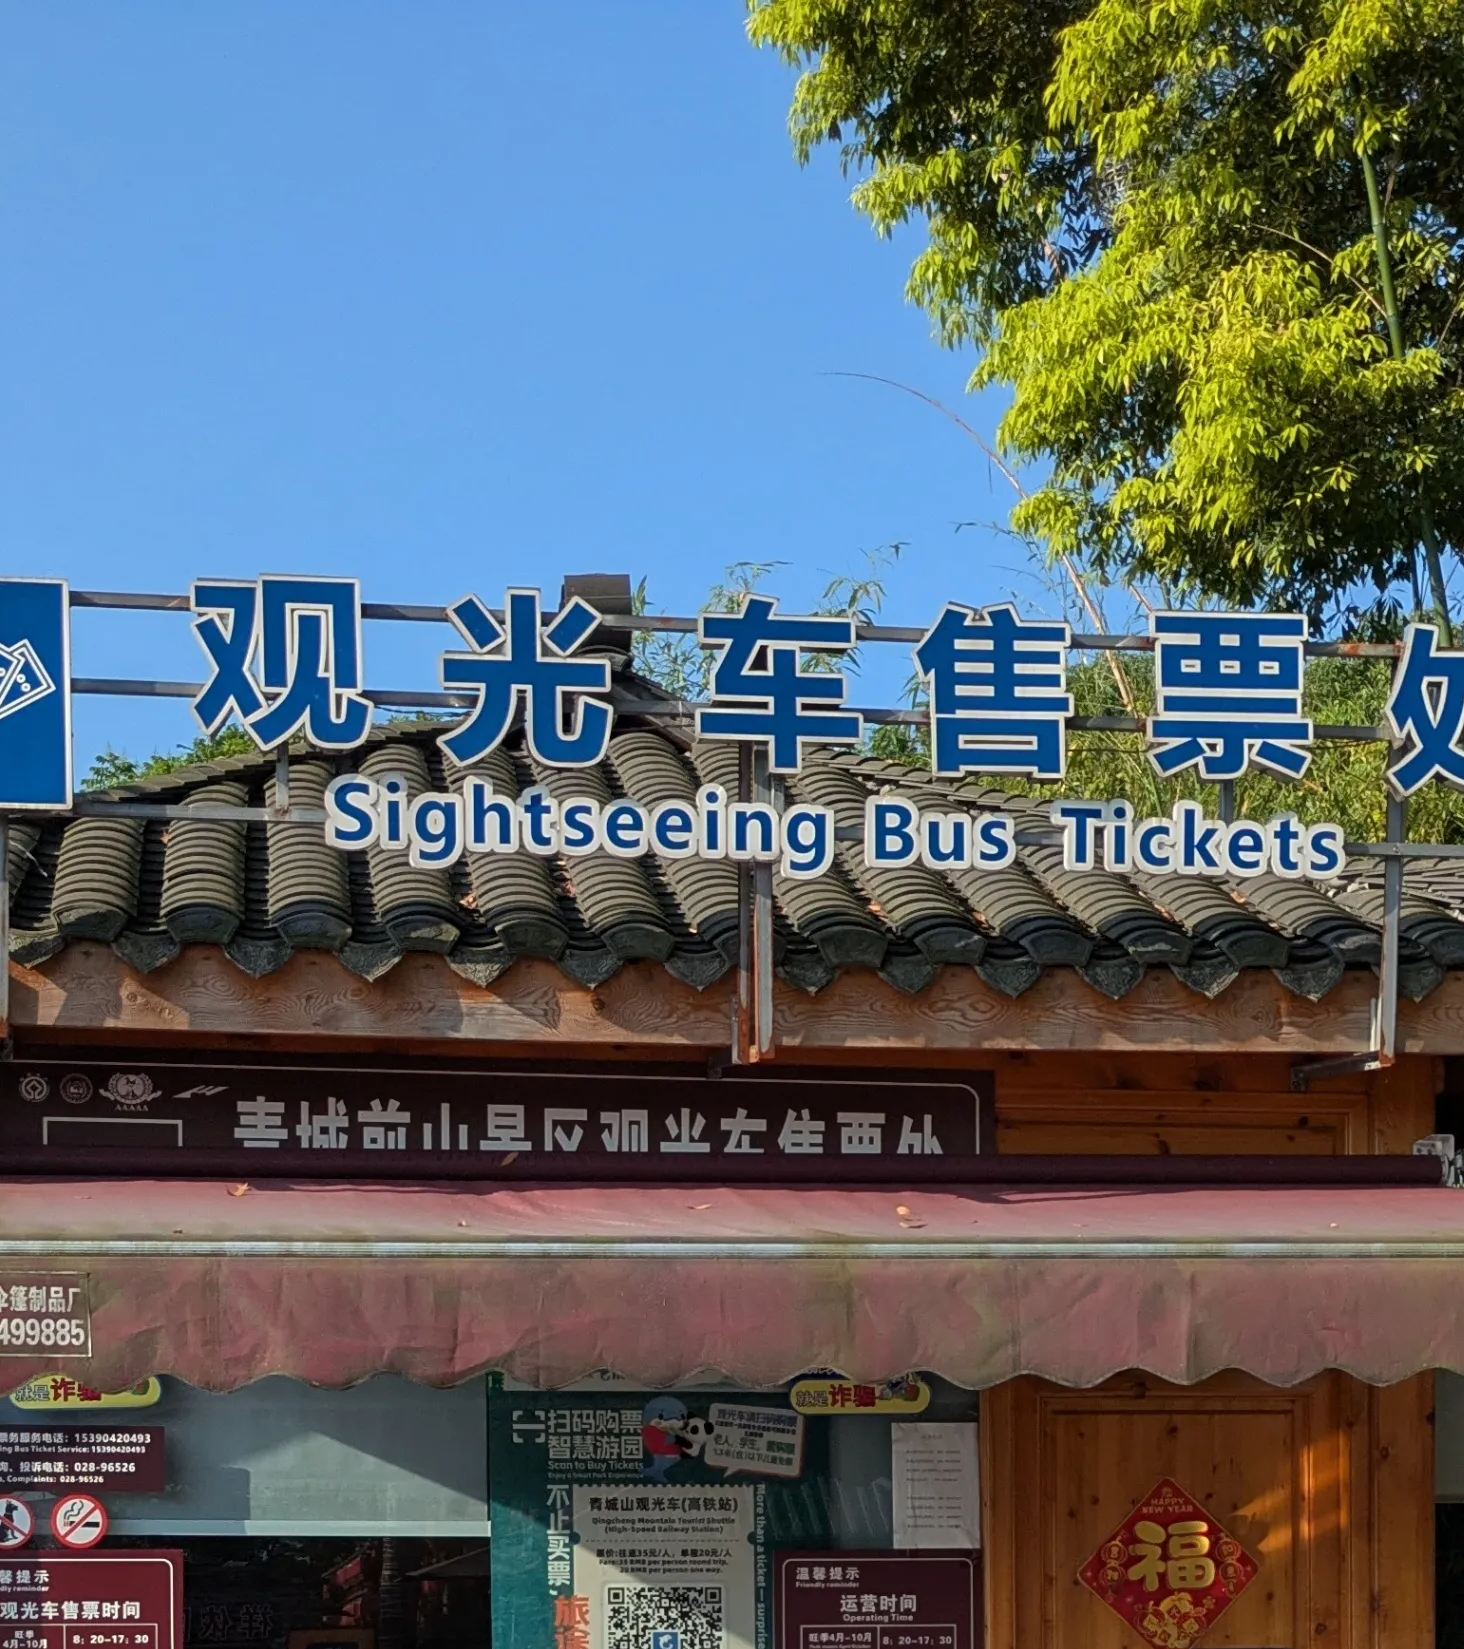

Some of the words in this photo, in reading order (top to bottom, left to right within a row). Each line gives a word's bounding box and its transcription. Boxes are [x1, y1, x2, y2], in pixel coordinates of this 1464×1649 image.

[324, 773, 833, 877] Sightseeing
[866, 797, 1019, 872] Bus
[1061, 802, 1345, 881] Tickets
[549, 1408, 643, 1433] 扫码购票
[14, 1445, 29, 1453] Bus
[549, 1434, 643, 1458] 智慧游园
[1150, 1497, 1184, 1506] HAPPY
[1168, 1504, 1194, 1513] YEAR
[1127, 1521, 1215, 1591] 福
[796, 1567, 860, 1580] 温馨提示
[0, 1601, 141, 1620] 观光车售票时间
[840, 1594, 917, 1612] 运营时间
[843, 1614, 888, 1622] Operating
